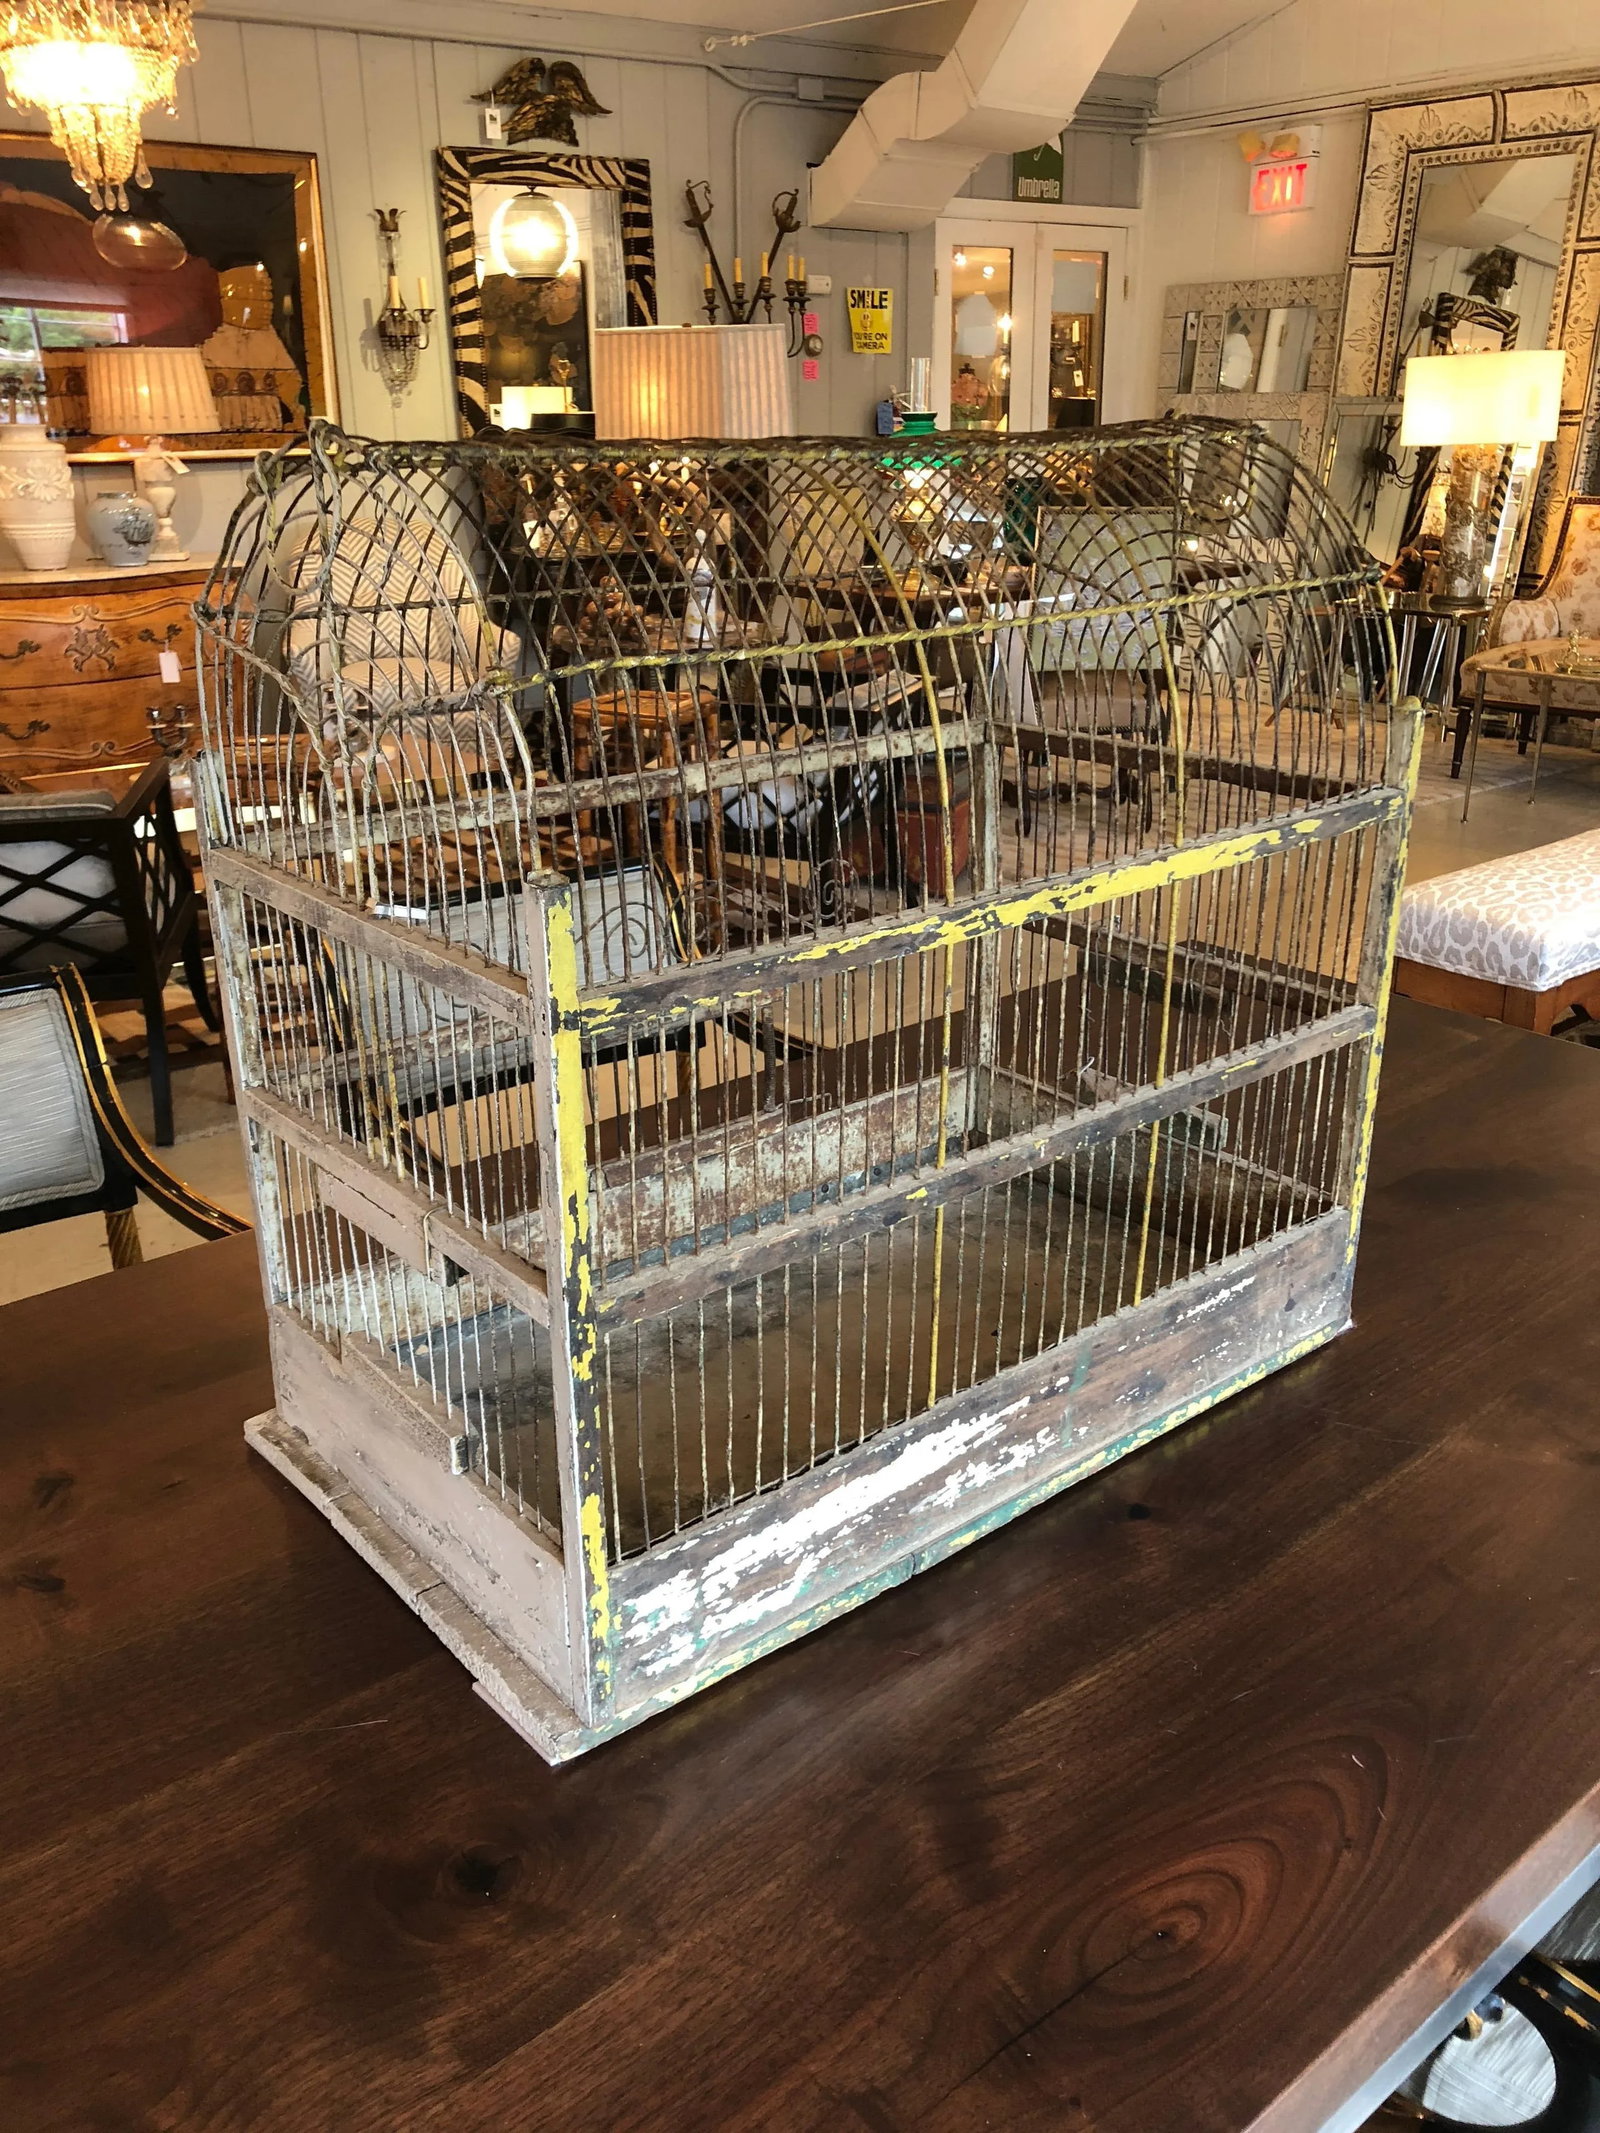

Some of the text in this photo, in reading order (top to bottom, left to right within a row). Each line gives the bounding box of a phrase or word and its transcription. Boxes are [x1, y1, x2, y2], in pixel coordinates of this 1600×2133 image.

[1017, 176, 1060, 199] Umbrella
[1253, 163, 1307, 210] EXIT
[850, 289, 889, 309] SMILE
[874, 332, 888, 341] ON
